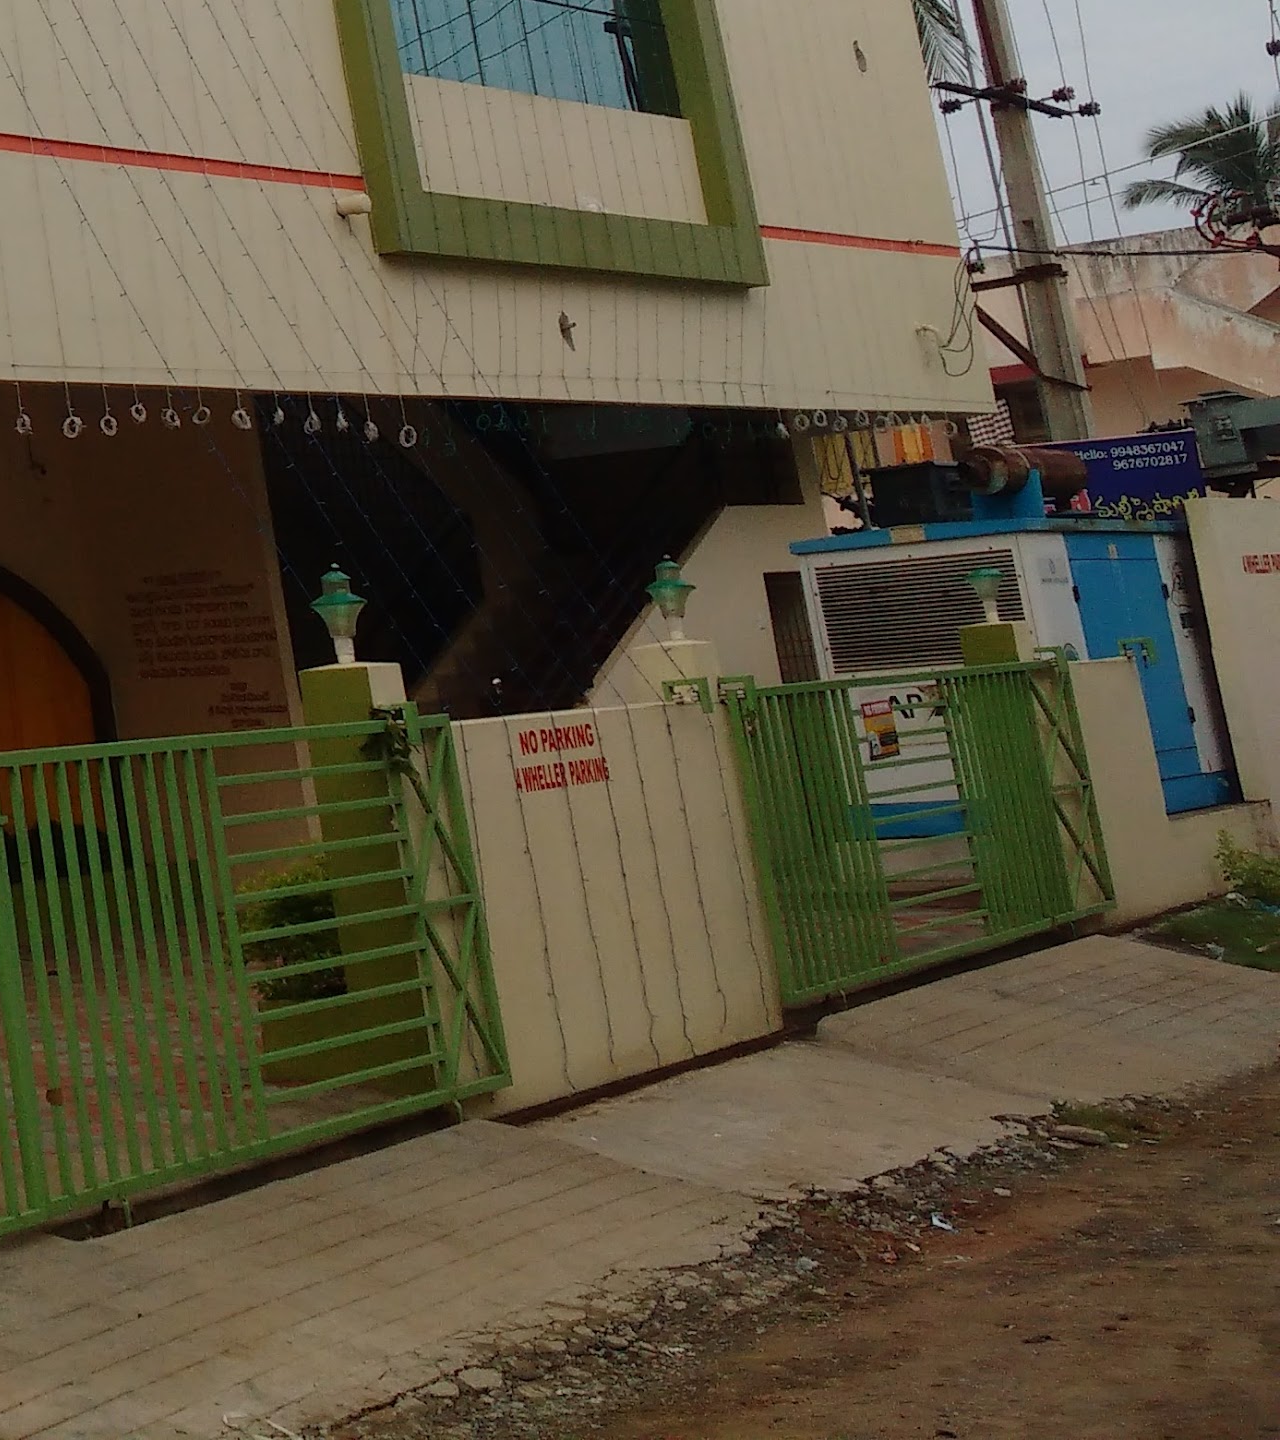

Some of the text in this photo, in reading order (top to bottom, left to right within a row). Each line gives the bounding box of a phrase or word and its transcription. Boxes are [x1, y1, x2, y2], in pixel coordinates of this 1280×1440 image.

[1112, 453, 1188, 471] 9676702817
[519, 723, 594, 756] NO PARKING
[568, 757, 610, 786] PARKING
